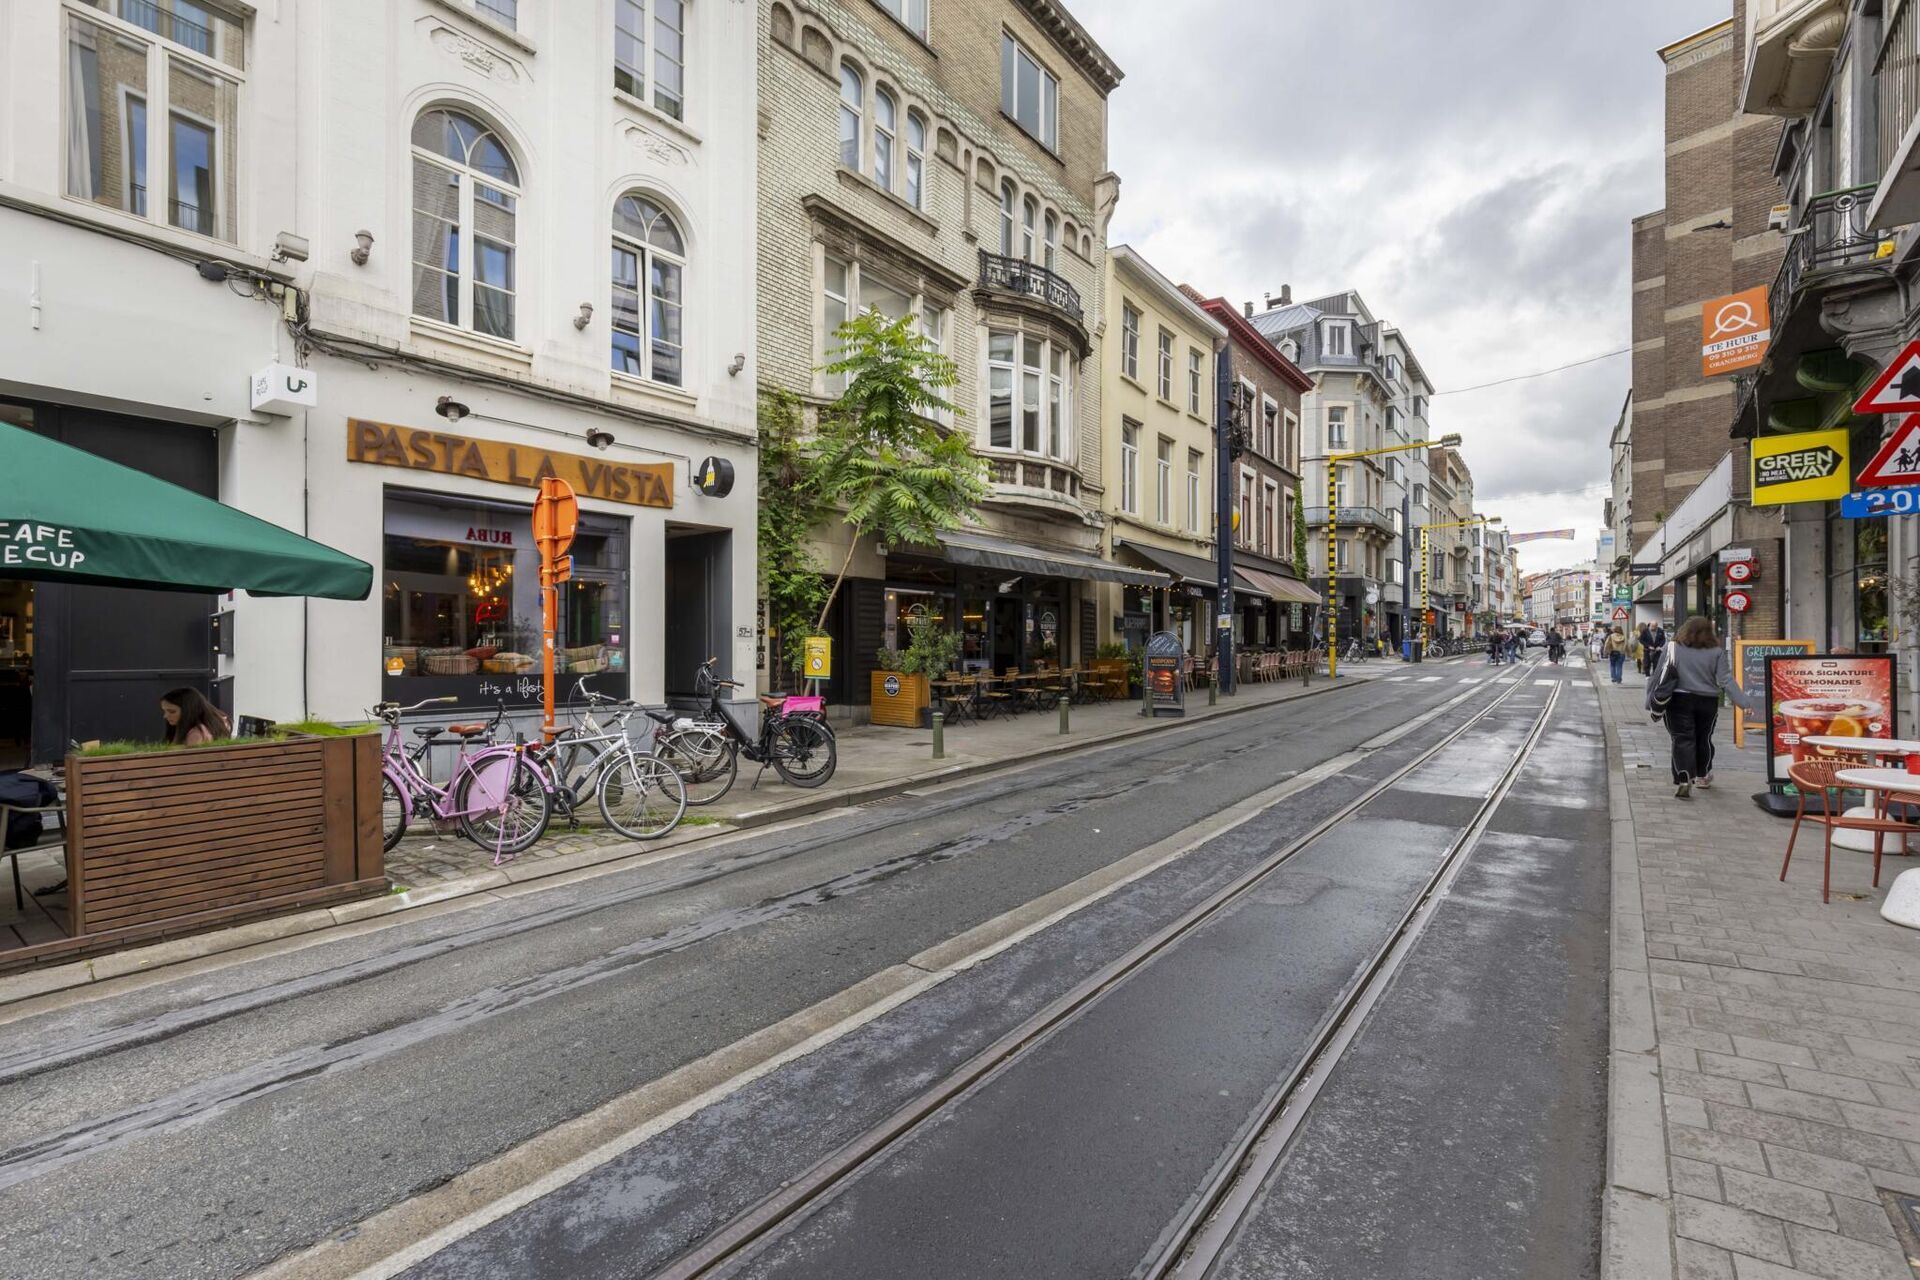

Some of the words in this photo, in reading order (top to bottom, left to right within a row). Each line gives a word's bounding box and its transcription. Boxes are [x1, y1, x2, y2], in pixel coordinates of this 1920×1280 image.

[1709, 342, 1724, 352] TE
[1726, 334, 1758, 348] HUUR
[1721, 349, 1735, 358] 310
[1744, 344, 1758, 352] 310
[354, 420, 490, 479] PASTA
[507, 447, 558, 486] LA
[578, 459, 671, 506] VISTA
[1759, 450, 1833, 470] GREEN
[1785, 463, 1833, 480] WAY
[479, 680, 501, 695] it's
[505, 686, 513, 694] a
